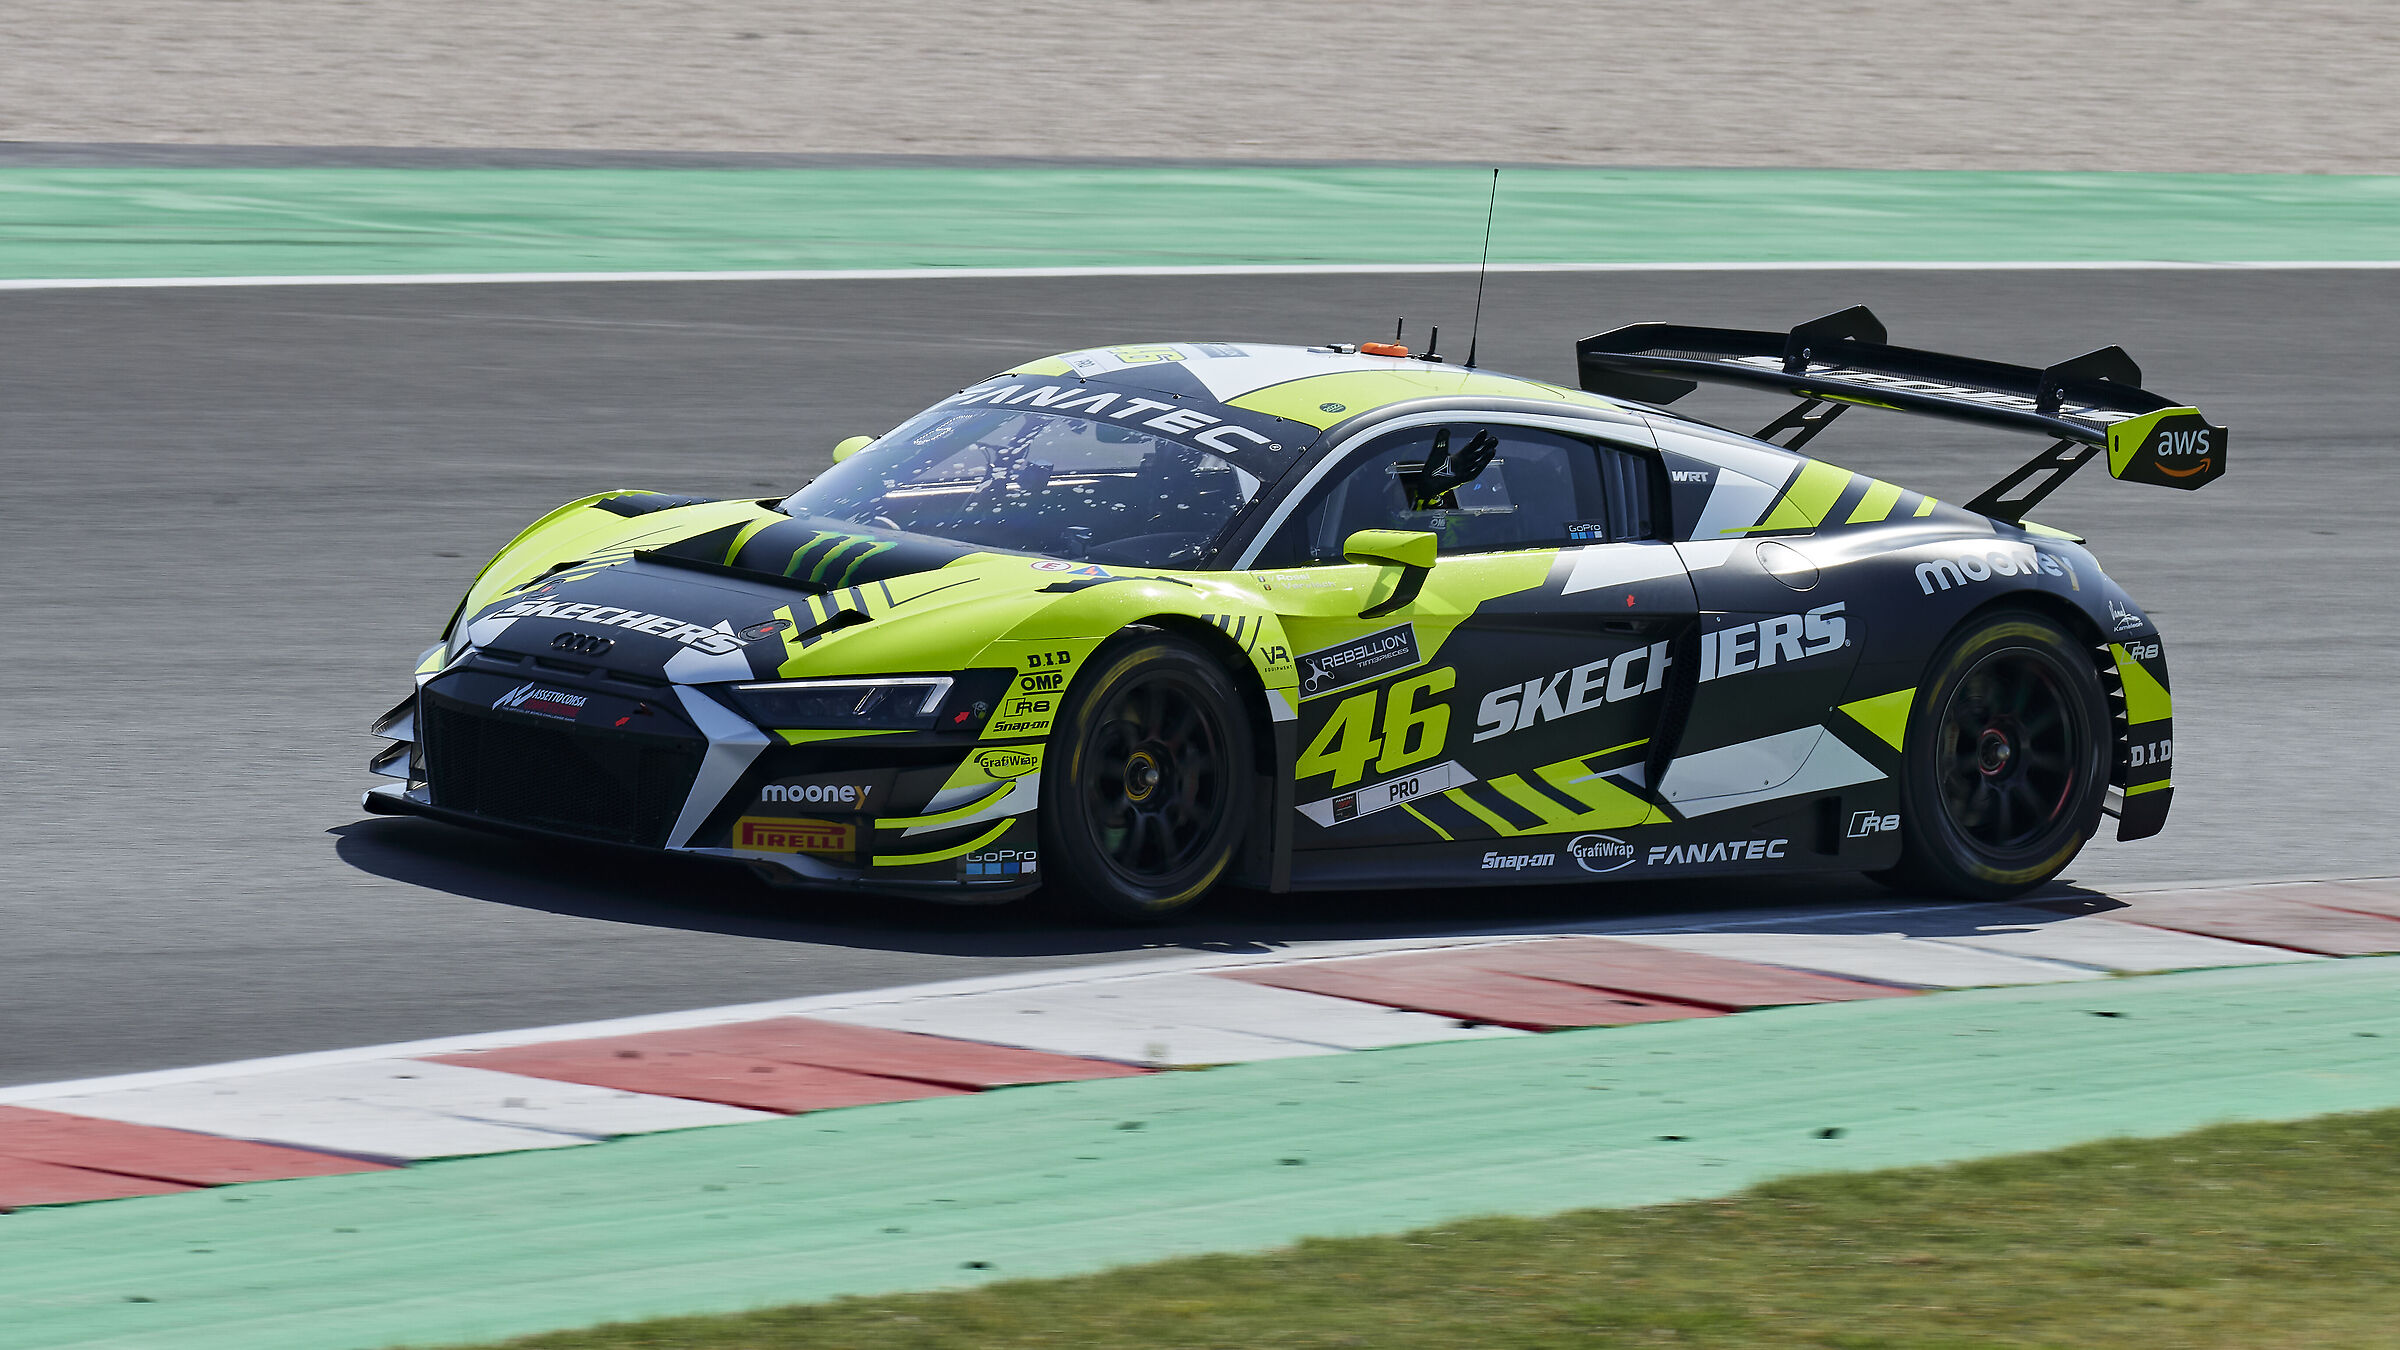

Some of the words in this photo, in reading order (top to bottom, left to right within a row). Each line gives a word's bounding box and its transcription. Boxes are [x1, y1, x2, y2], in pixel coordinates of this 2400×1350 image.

[955, 384, 1272, 455] FANATEC
[2157, 429, 2210, 457] aws
[1671, 470, 1709, 482] WRT
[1568, 523, 1602, 533] GoPro
[1914, 551, 2081, 596] mooney
[494, 598, 750, 656] SKECHERS
[1260, 645, 1290, 665] VR
[2130, 643, 2160, 661] R8
[1020, 673, 1063, 691] OMP
[1472, 600, 1848, 744] SKECHERS
[1014, 700, 1051, 714] R8
[992, 720, 1050, 733] Snap-on
[1294, 666, 1457, 790] 46
[980, 754, 1038, 768] GrafiWrap
[761, 784, 872, 811] mooney
[1389, 778, 1419, 802] PRO
[1860, 814, 1901, 834] R8
[741, 821, 848, 851] PIRELLI
[965, 849, 1037, 862] GoPro
[1481, 850, 1557, 871] Snap-on
[1572, 844, 1635, 859] GrafiWrap
[1647, 839, 1789, 866] FANATEC
